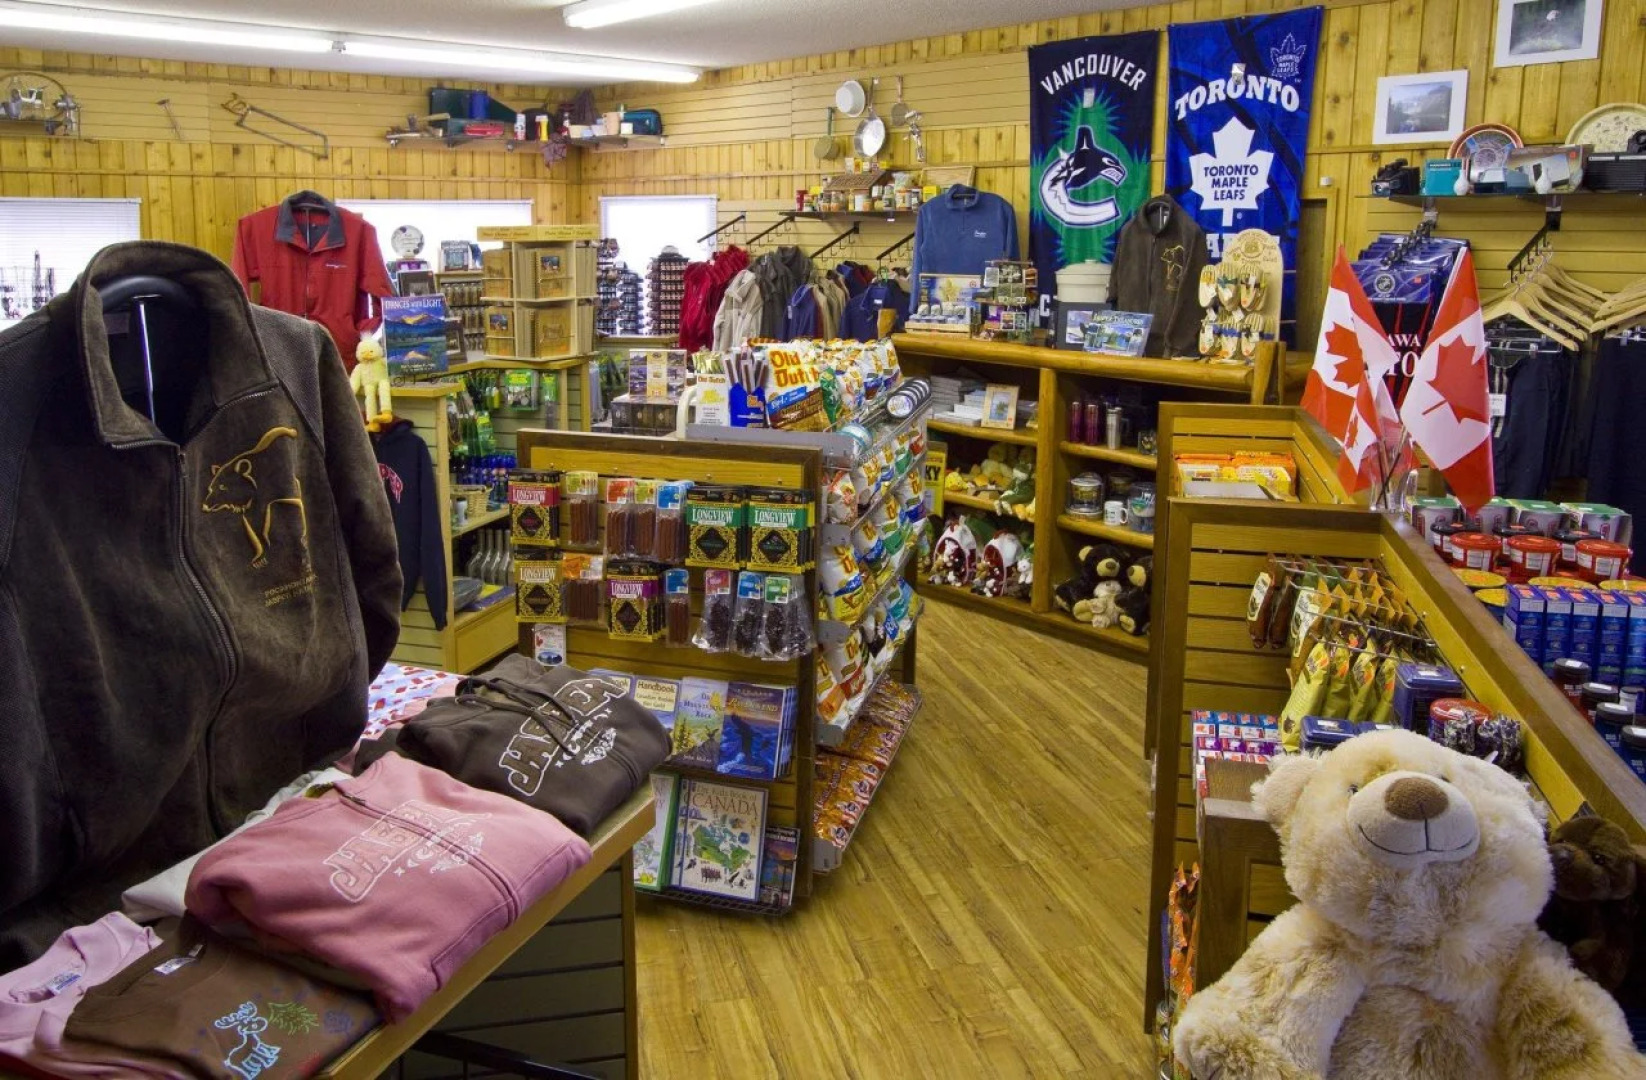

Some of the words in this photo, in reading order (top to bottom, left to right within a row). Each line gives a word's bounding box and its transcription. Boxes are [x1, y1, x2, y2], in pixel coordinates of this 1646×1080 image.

[1041, 53, 1147, 95] VANCOUVER
[1175, 74, 1300, 121] TORONTO
[1203, 164, 1259, 176] TORONTO
[1211, 177, 1249, 189] MAPLE
[1213, 190, 1246, 201] LEAFS
[385, 300, 410, 310] DANCES
[423, 299, 441, 308] LIGHT
[769, 350, 801, 368] Old
[512, 488, 546, 503] LONGVIEW
[692, 508, 734, 523] LONGVIEW
[755, 510, 796, 526] LONGVIEW
[520, 566, 556, 580] LONGVIEW
[611, 582, 643, 597] LONGVIEW
[637, 682, 676, 694] Handbook
[692, 792, 758, 816] CANADA
